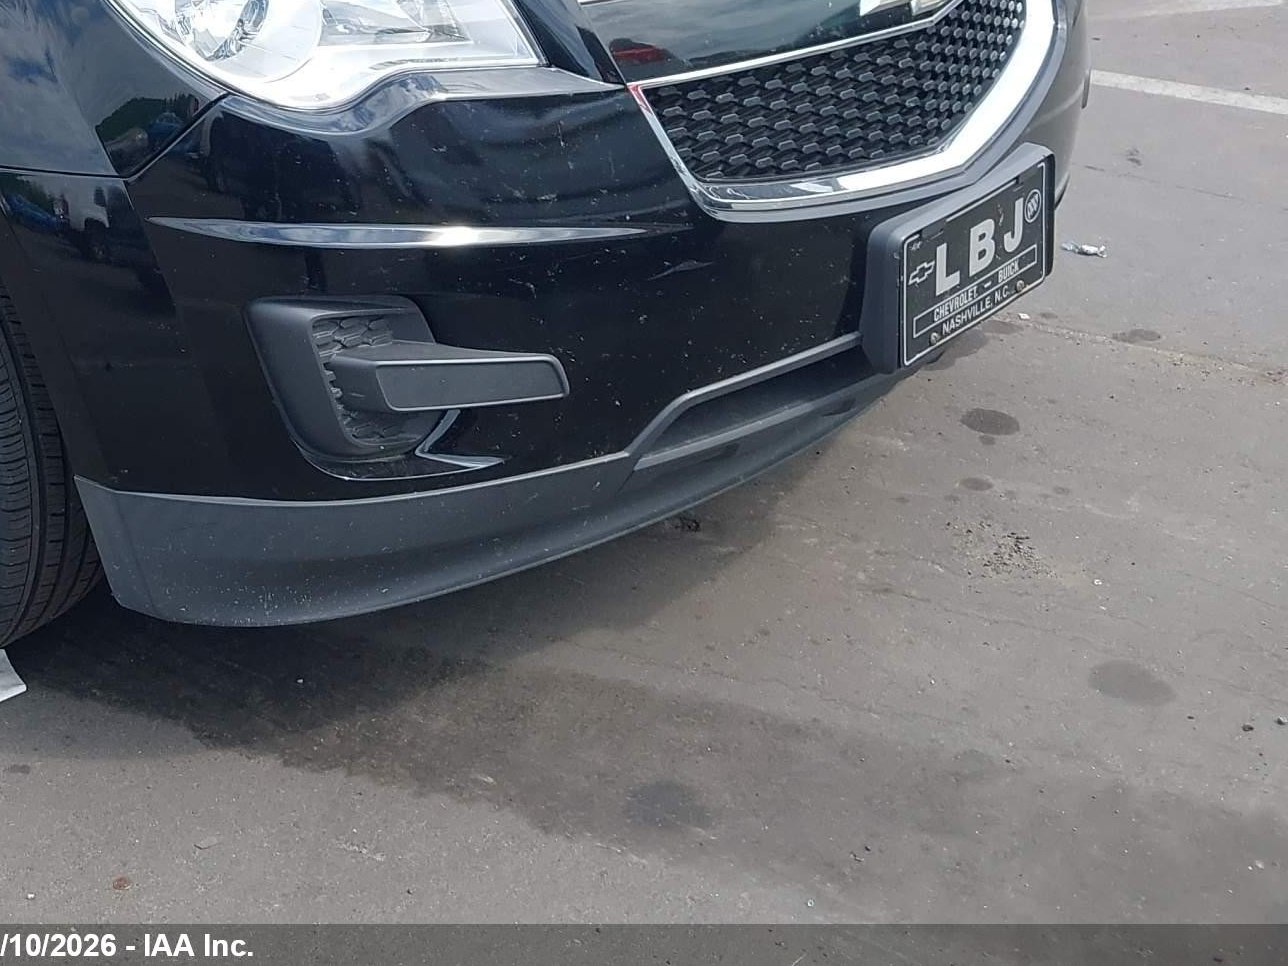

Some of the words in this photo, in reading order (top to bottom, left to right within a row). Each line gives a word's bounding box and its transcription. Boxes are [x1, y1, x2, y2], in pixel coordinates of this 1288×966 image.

[933, 285, 978, 322] CHEVROLET
[997, 258, 1019, 283] BUICK
[942, 296, 993, 335] NASHVILLE,
[994, 285, 1011, 305] N.C.
